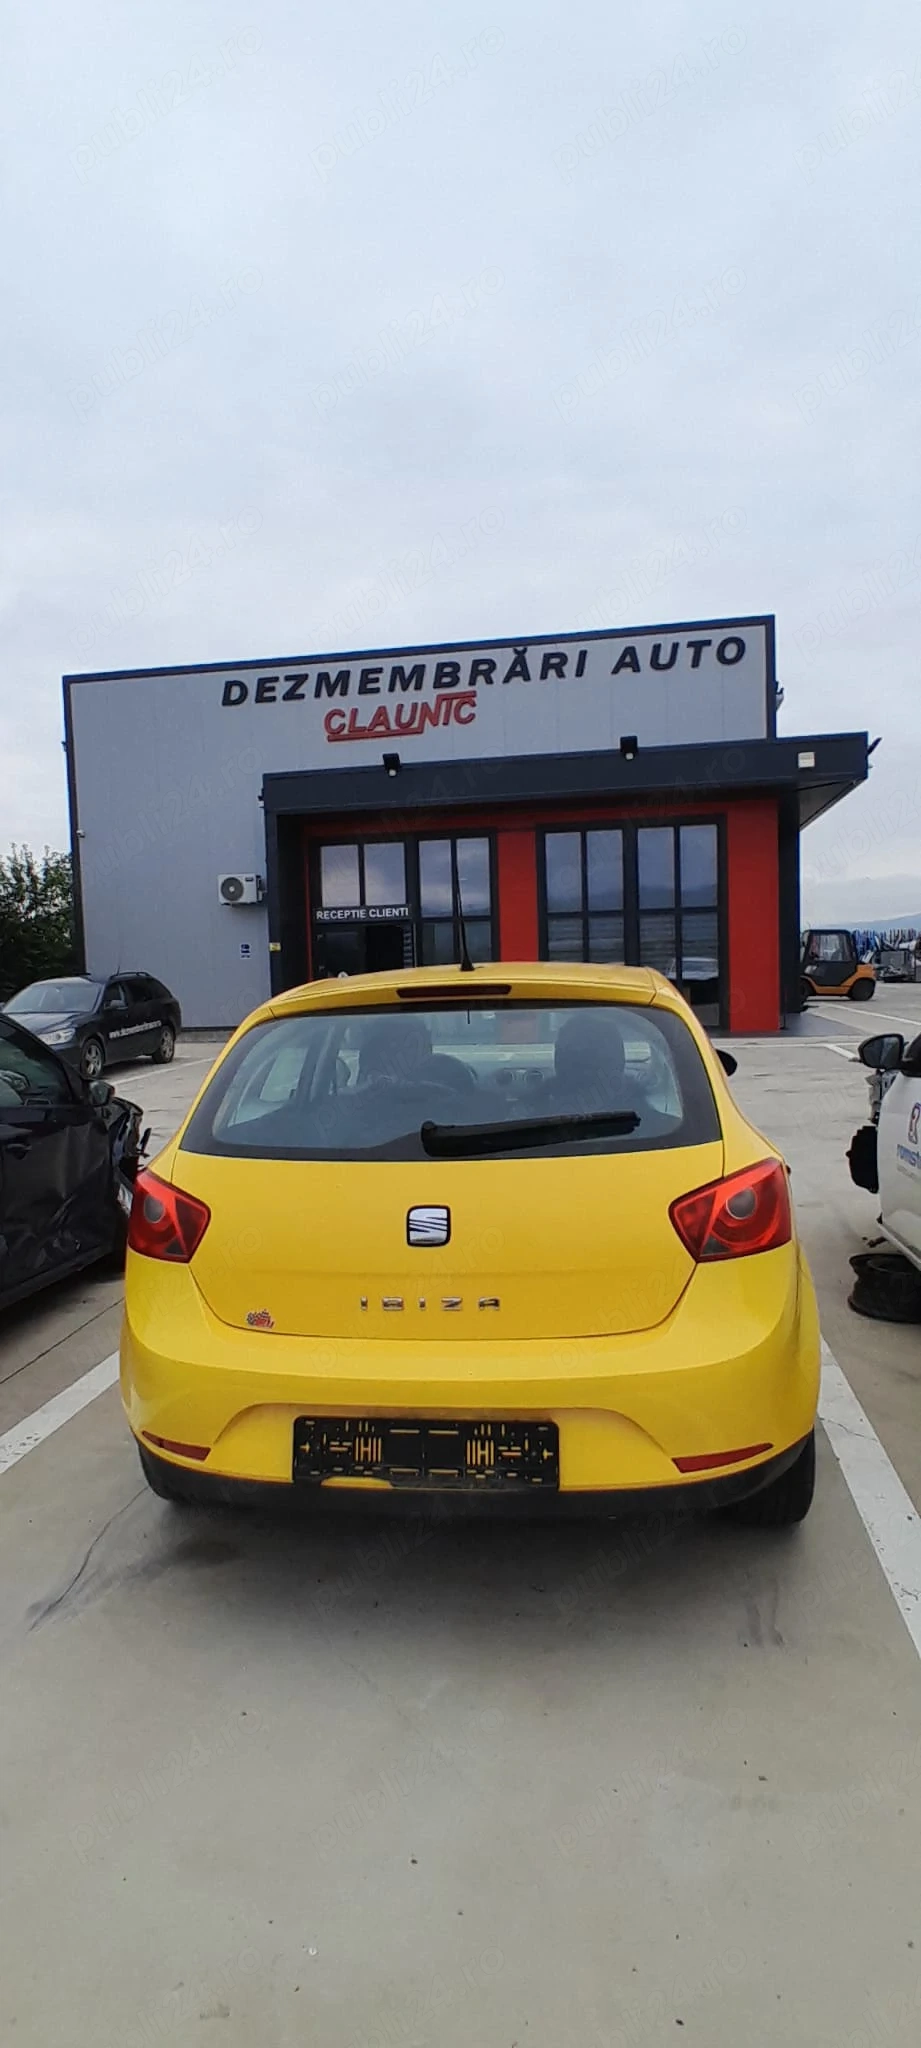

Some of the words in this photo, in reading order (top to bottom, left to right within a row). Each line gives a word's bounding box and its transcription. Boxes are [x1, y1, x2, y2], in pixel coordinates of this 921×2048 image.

[222, 647, 588, 706] DEZMEMBRĂRI
[611, 636, 748, 676] AUTO
[324, 691, 478, 741] CLAUNIC
[316, 909, 366, 920] RECEPTIE
[369, 907, 409, 918] CLIENTI
[359, 1296, 500, 1311] IBIZA
